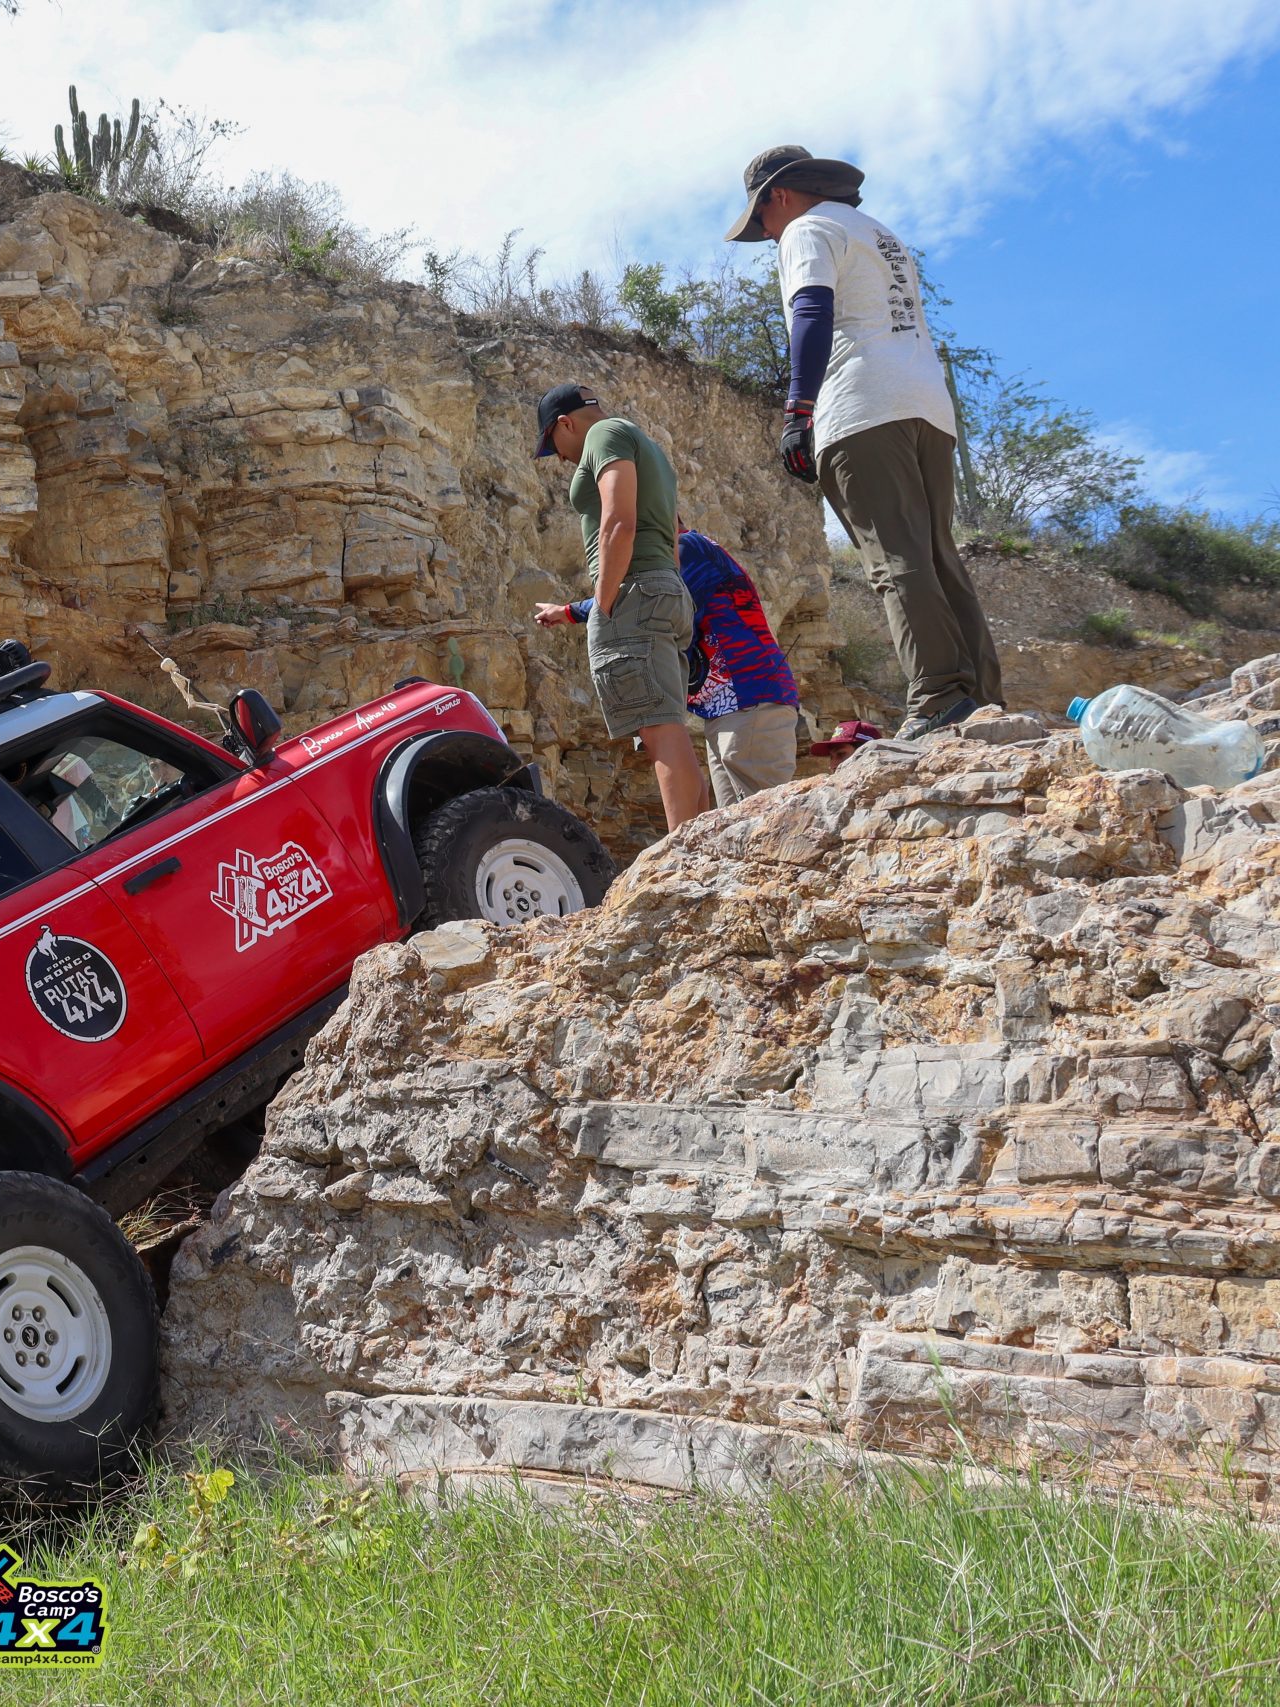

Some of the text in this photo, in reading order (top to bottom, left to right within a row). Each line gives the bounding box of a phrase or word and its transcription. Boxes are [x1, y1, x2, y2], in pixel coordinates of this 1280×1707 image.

[434, 698, 461, 716] Bronco
[299, 732, 343, 758] Bronco
[262, 851, 303, 881] Bosco's
[277, 868, 300, 887] Camp
[33, 951, 92, 989] BRONCO
[46, 955, 72, 973] FORD
[43, 965, 98, 1006] RUTAS
